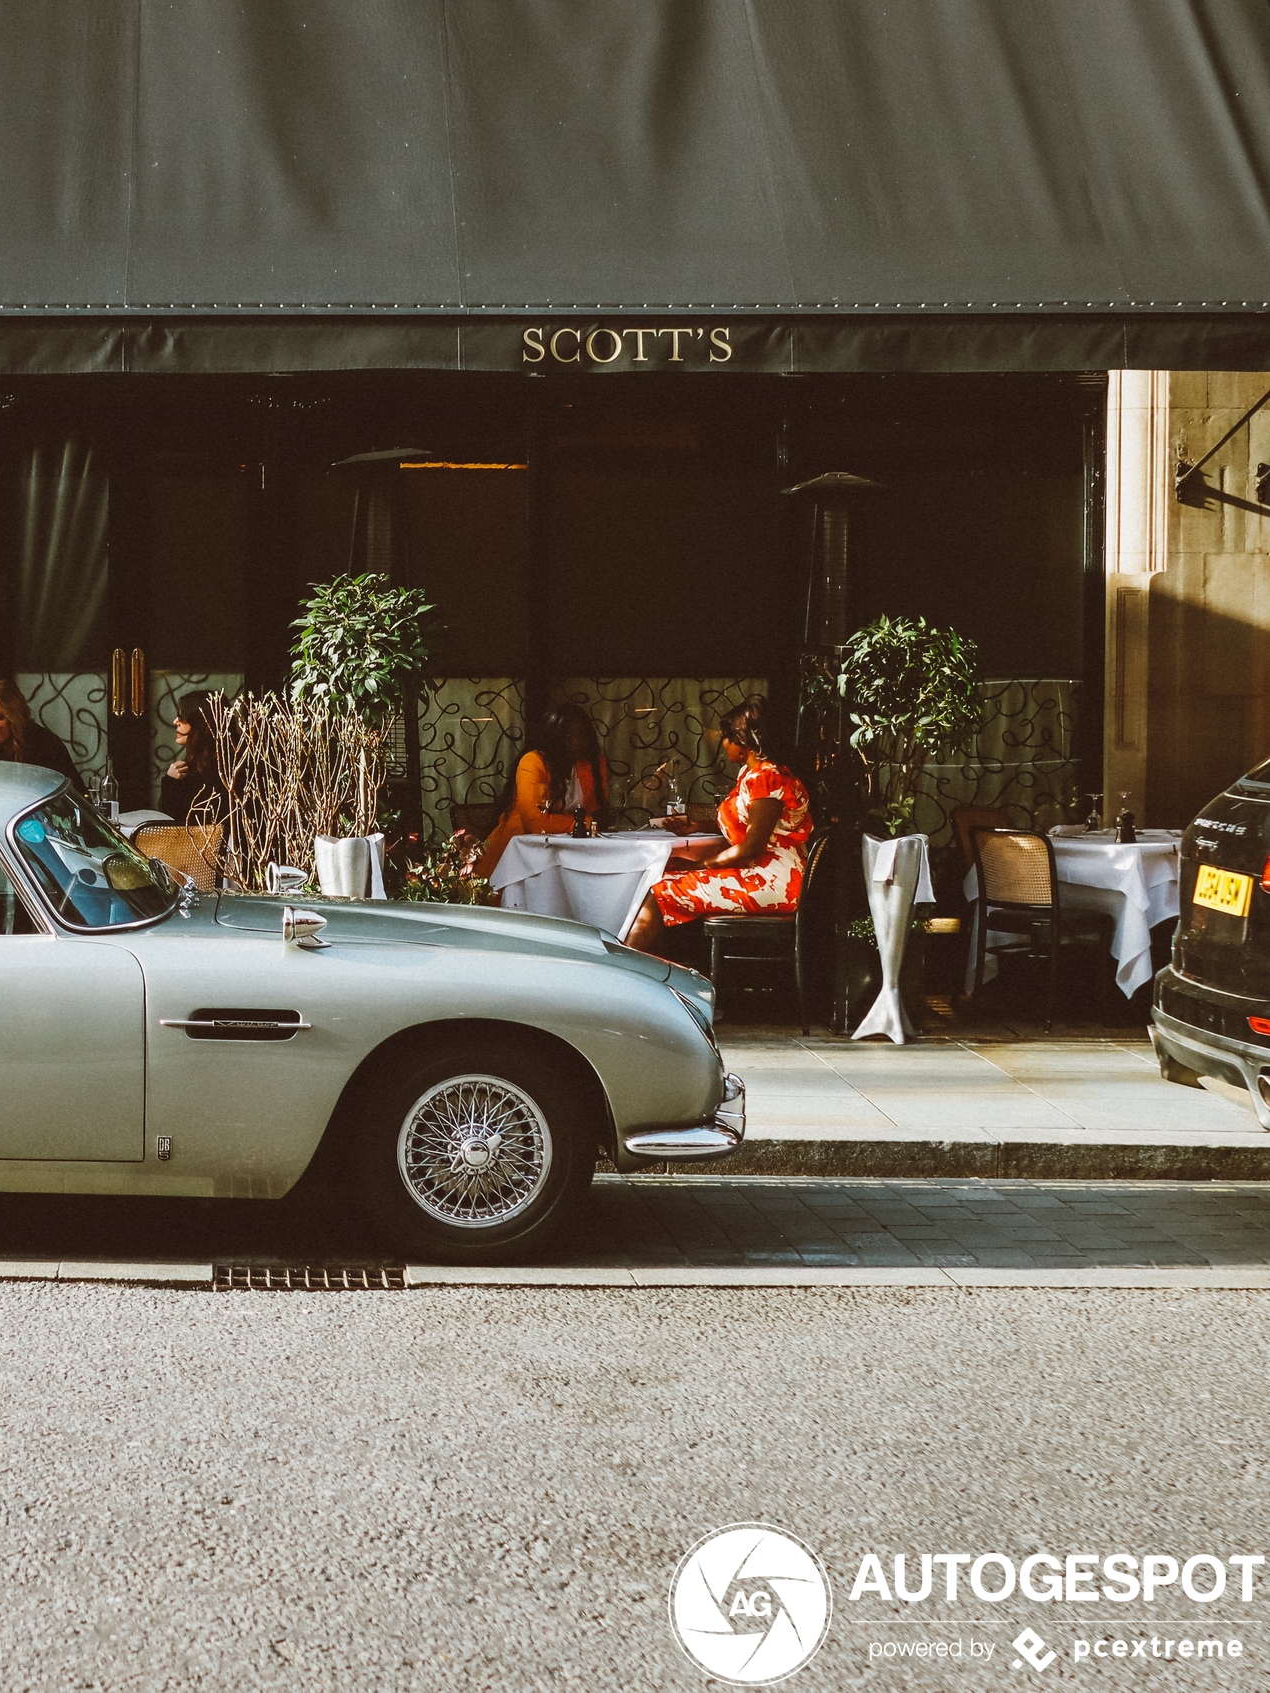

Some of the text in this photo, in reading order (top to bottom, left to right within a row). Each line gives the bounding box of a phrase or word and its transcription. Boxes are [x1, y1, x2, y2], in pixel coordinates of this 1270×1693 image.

[522, 326, 733, 364] SCOTT'S
[158, 1137, 170, 1152] DB
[158, 1151, 170, 1160] 5
